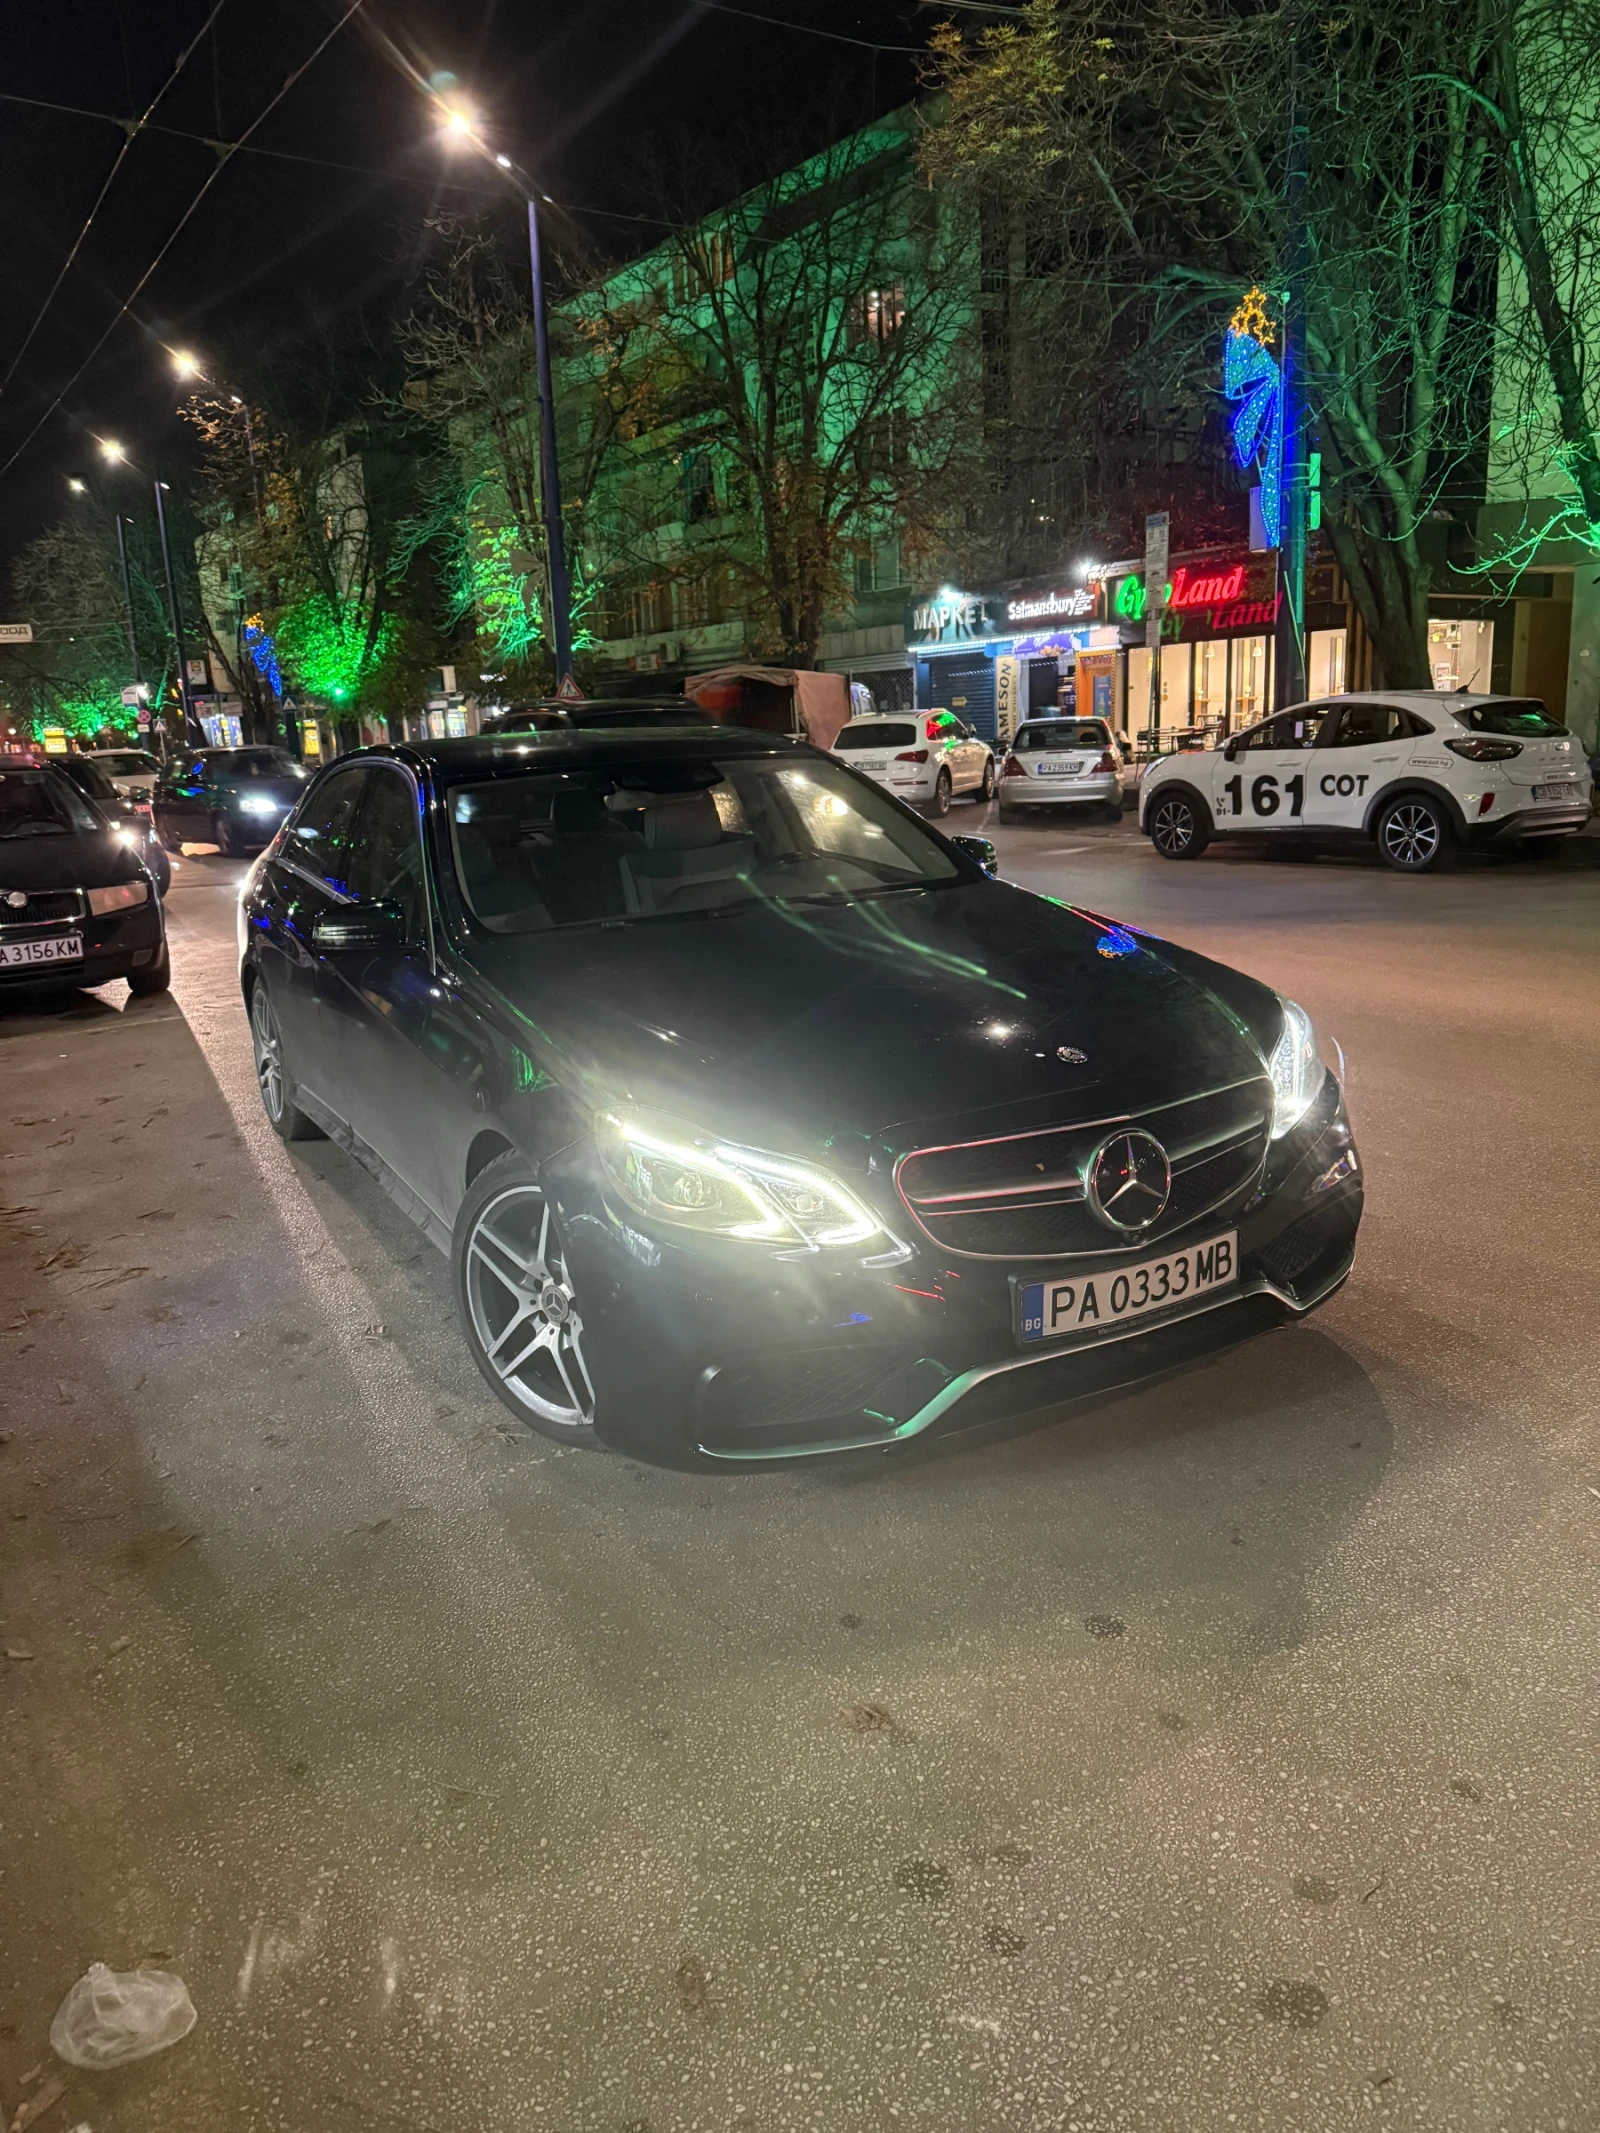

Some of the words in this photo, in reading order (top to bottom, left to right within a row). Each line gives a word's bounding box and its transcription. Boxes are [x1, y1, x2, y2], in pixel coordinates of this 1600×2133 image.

[1116, 574, 1172, 621] Gy
[1171, 565, 1244, 607] Land
[998, 663, 1011, 739] AMESON
[1224, 774, 1304, 817] 161
[1110, 1257, 1190, 1314] 0333
[1025, 1317, 1041, 1331] BG
